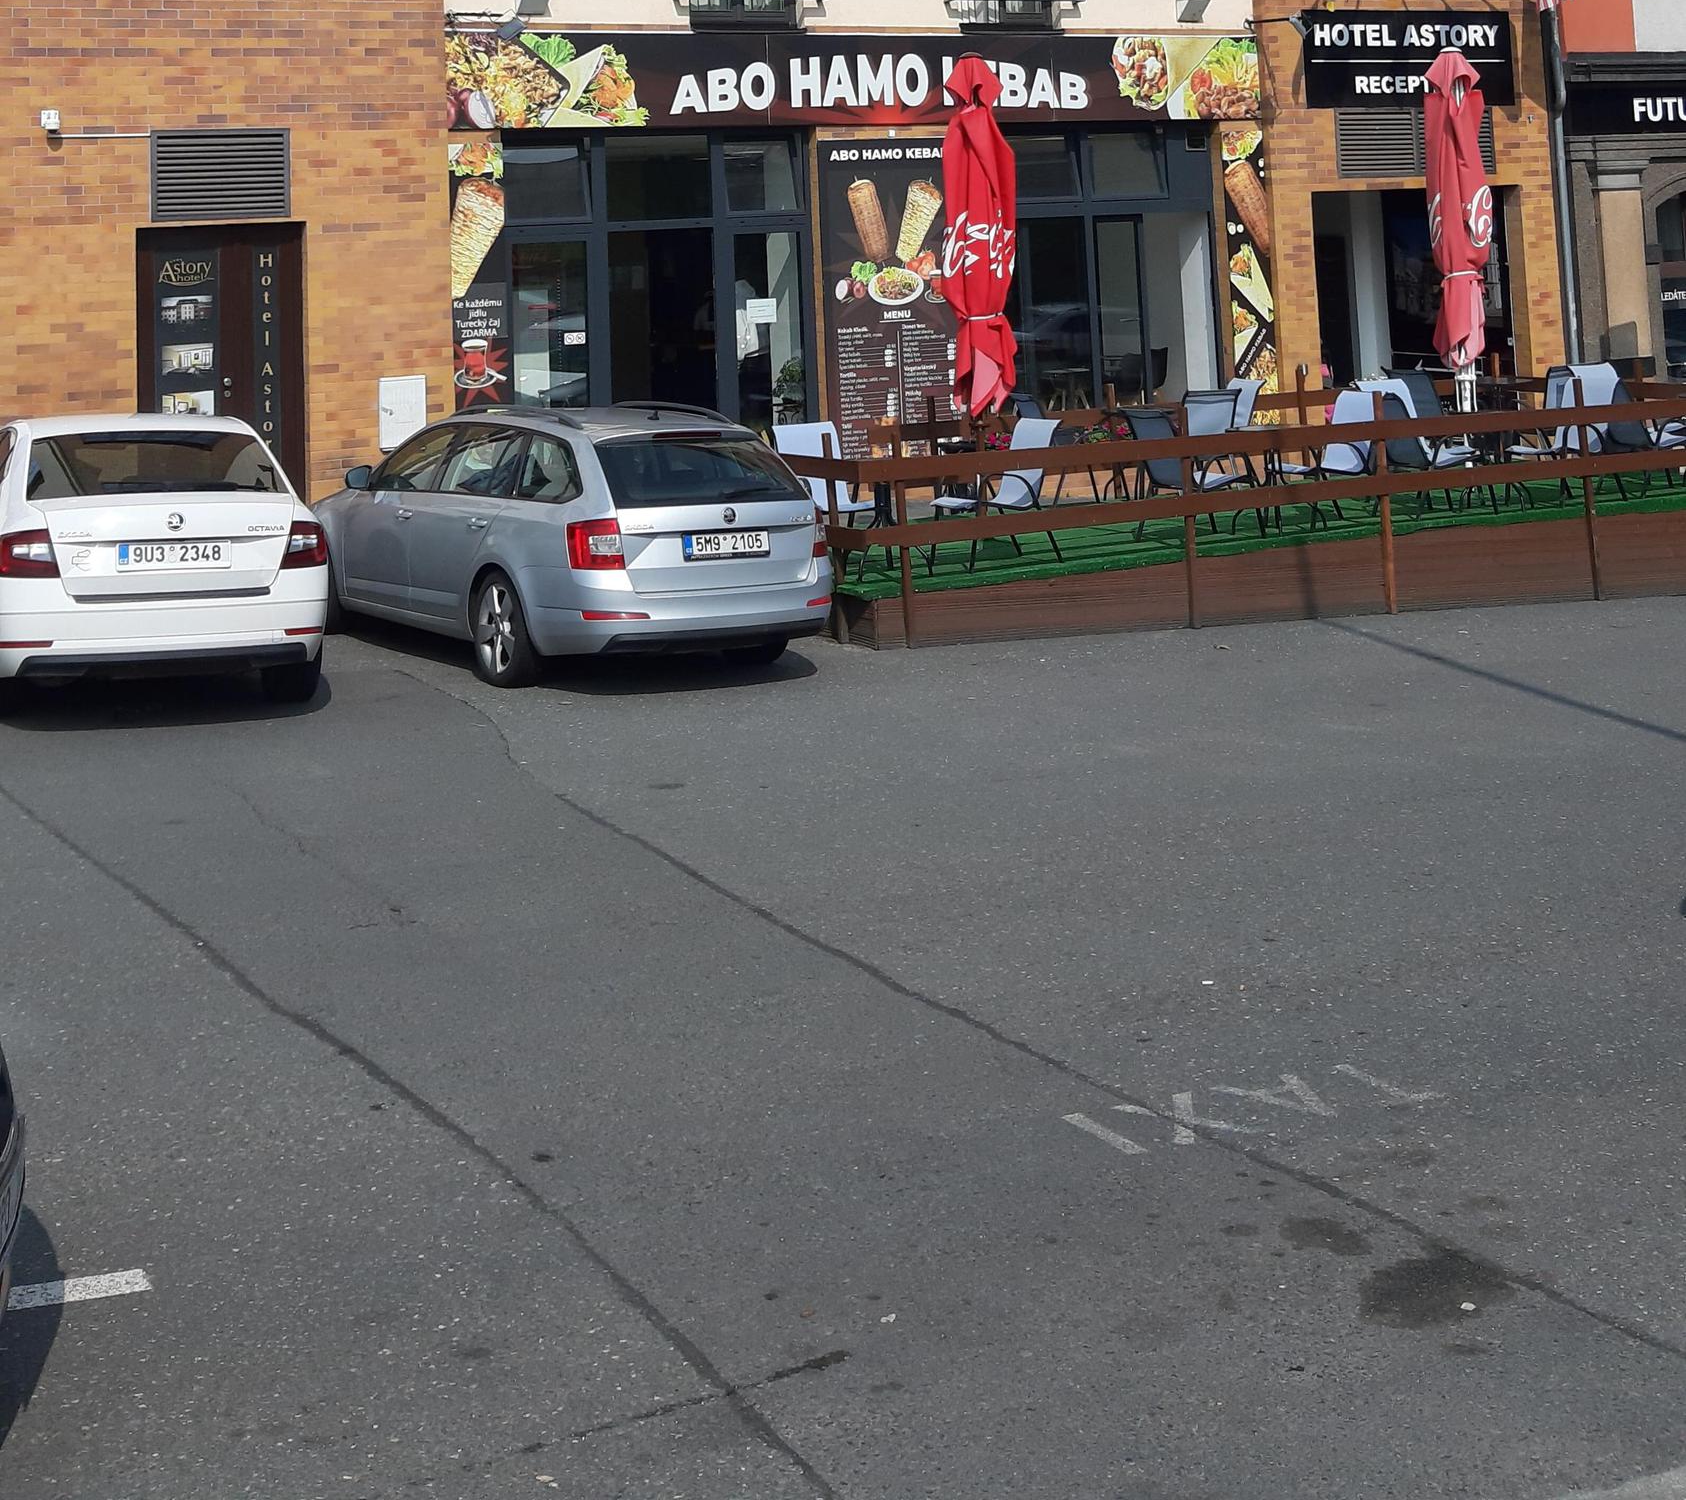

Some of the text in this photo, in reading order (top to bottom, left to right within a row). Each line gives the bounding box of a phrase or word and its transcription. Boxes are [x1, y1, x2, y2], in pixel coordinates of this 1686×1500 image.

[1314, 24, 1499, 47] HOTEL ASTORY
[669, 54, 1089, 115] ABO HAMO BAB
[1355, 75, 1430, 94] RECEPT
[830, 147, 943, 161] ABO HAMO KEBA
[158, 260, 212, 283] Astory
[177, 273, 204, 282] hotel
[1661, 287, 1686, 301] LEDÁTE
[453, 298, 502, 309] Ke každému
[883, 309, 911, 320] MENU
[455, 319, 488, 329] Turecký
[461, 328, 498, 338] ZDARMA
[259, 254, 273, 449] Hotel Astor
[247, 523, 285, 532] OCTAVIA
[696, 534, 763, 552] 5M9 2105
[133, 545, 221, 563] 9U3 2348
